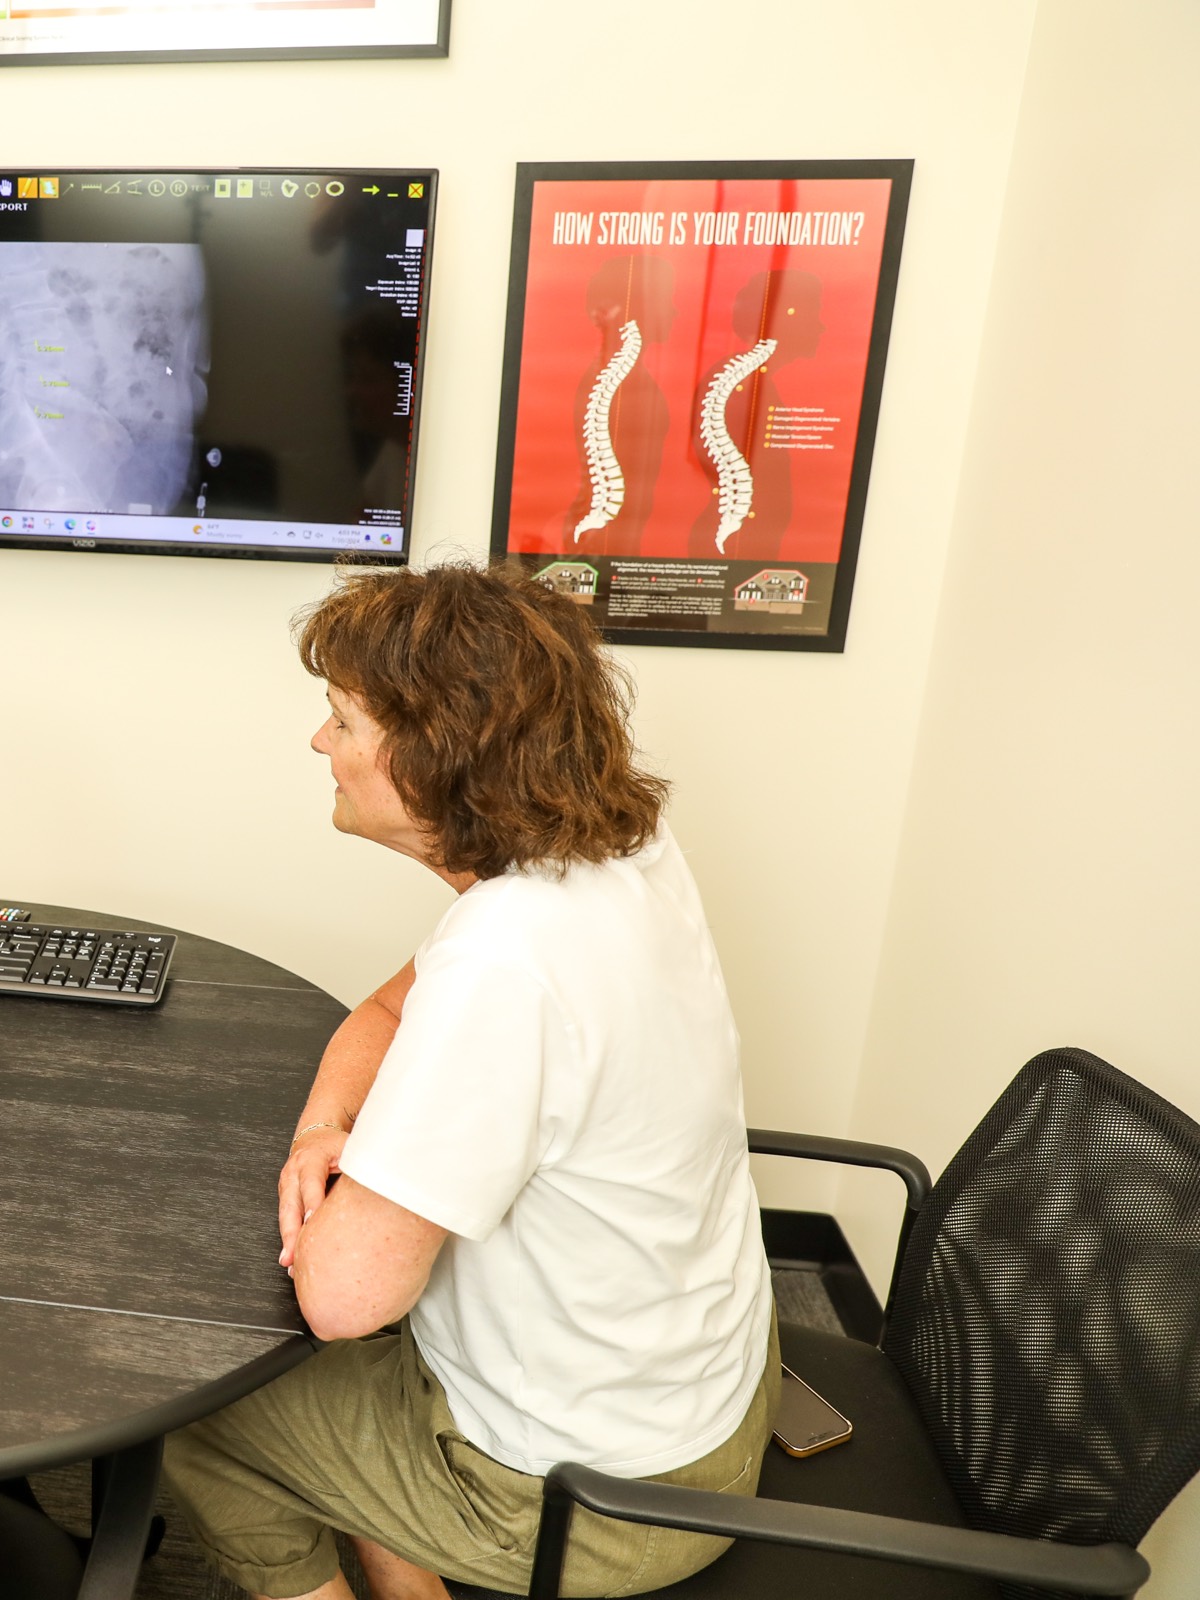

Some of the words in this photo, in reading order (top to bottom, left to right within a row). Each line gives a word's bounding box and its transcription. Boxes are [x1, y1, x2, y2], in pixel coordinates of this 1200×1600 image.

[553, 212, 594, 245] HOW
[597, 212, 664, 245] STRONG
[669, 212, 687, 245] IS
[693, 212, 739, 245] YOUR
[744, 212, 865, 246] FOUNDATION?
[72, 540, 96, 548] VIZIO
